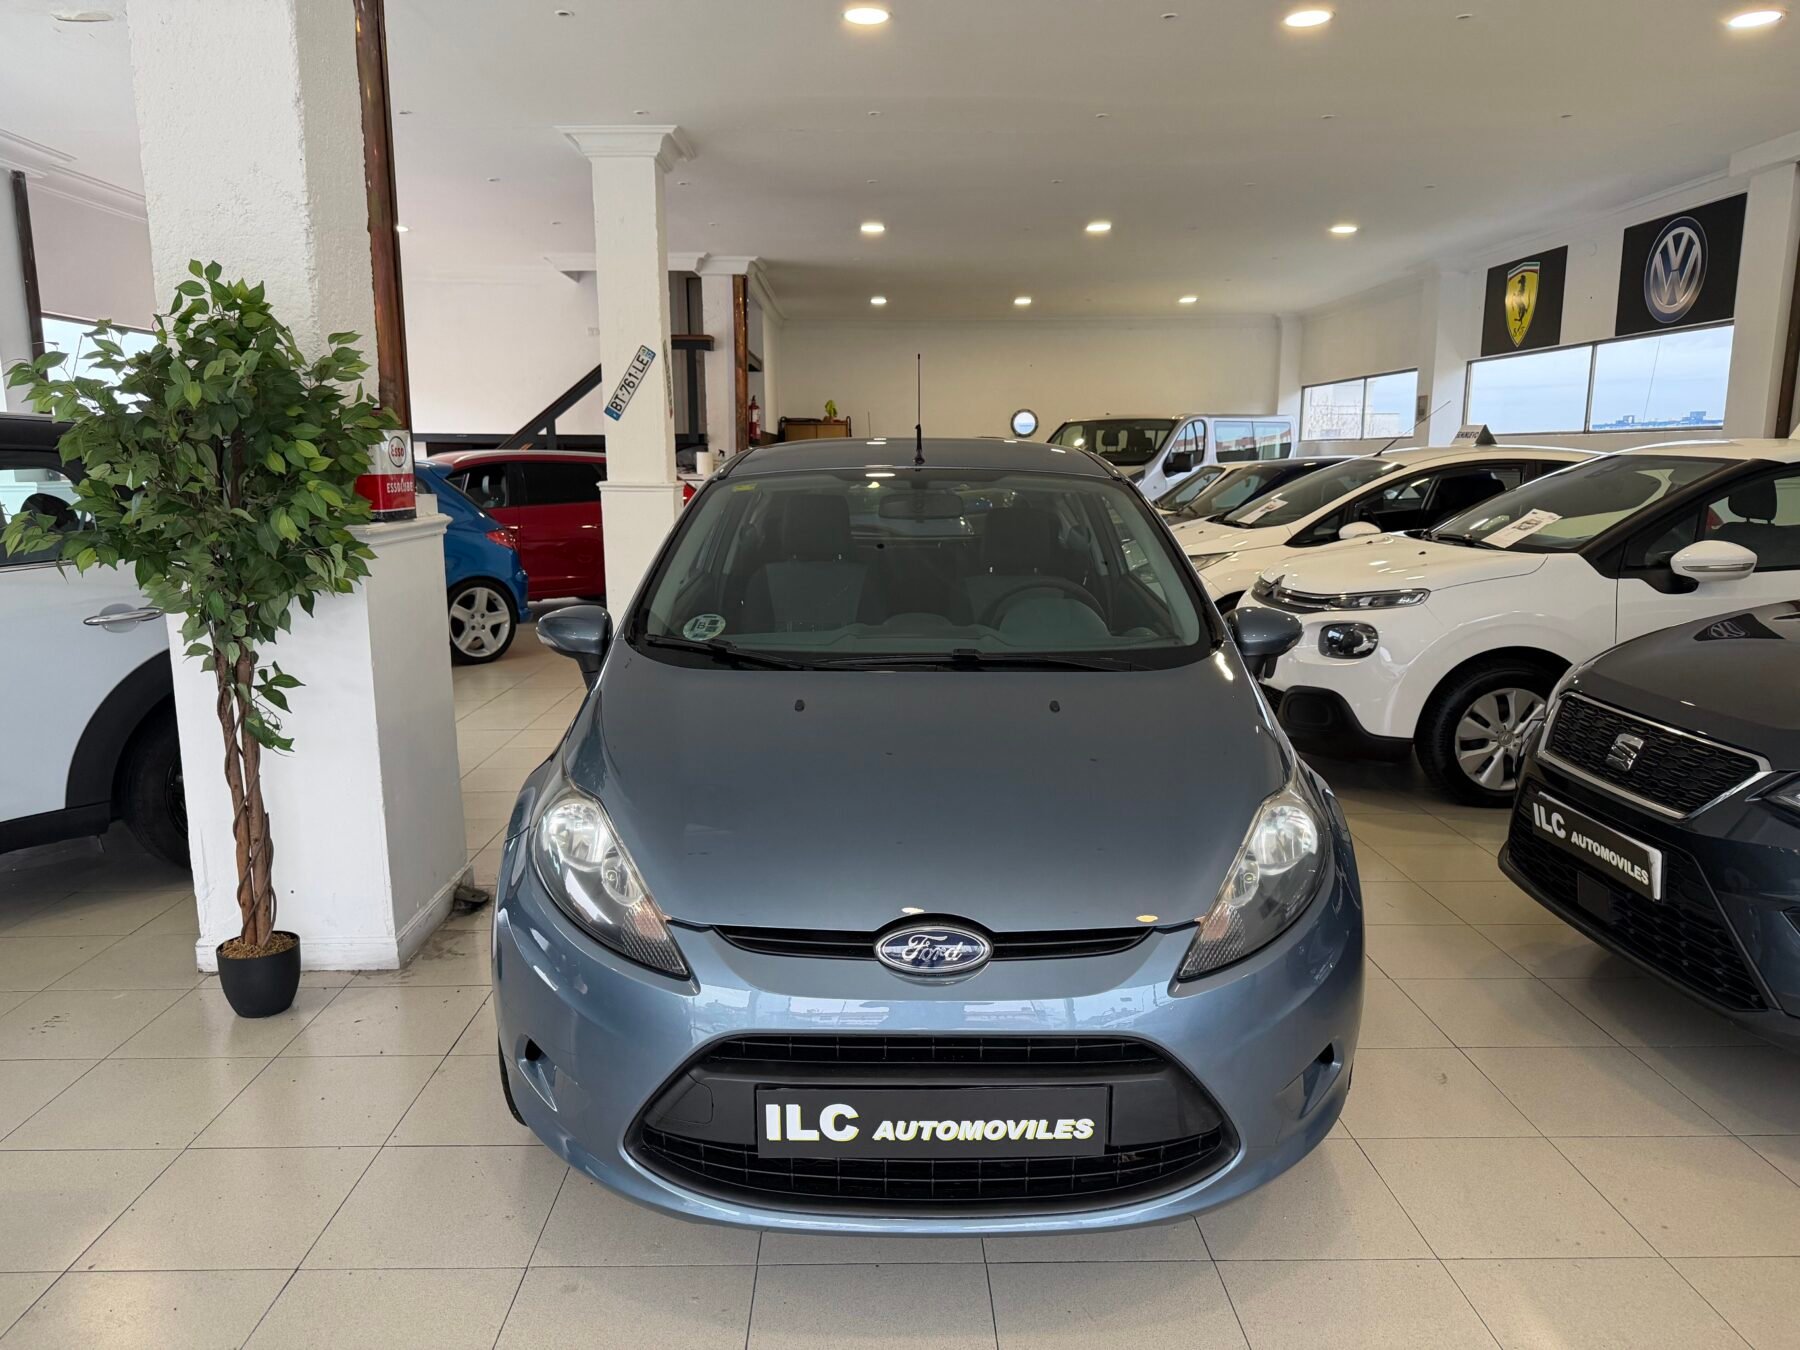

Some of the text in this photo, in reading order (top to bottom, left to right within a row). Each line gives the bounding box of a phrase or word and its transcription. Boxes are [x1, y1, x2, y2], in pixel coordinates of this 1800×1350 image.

[1654, 230, 1701, 308] VW
[1533, 802, 1649, 885] ILC AUTOMOVILES
[901, 934, 963, 961] Ford
[765, 1103, 1095, 1142] ILC AUTOMOVILES
